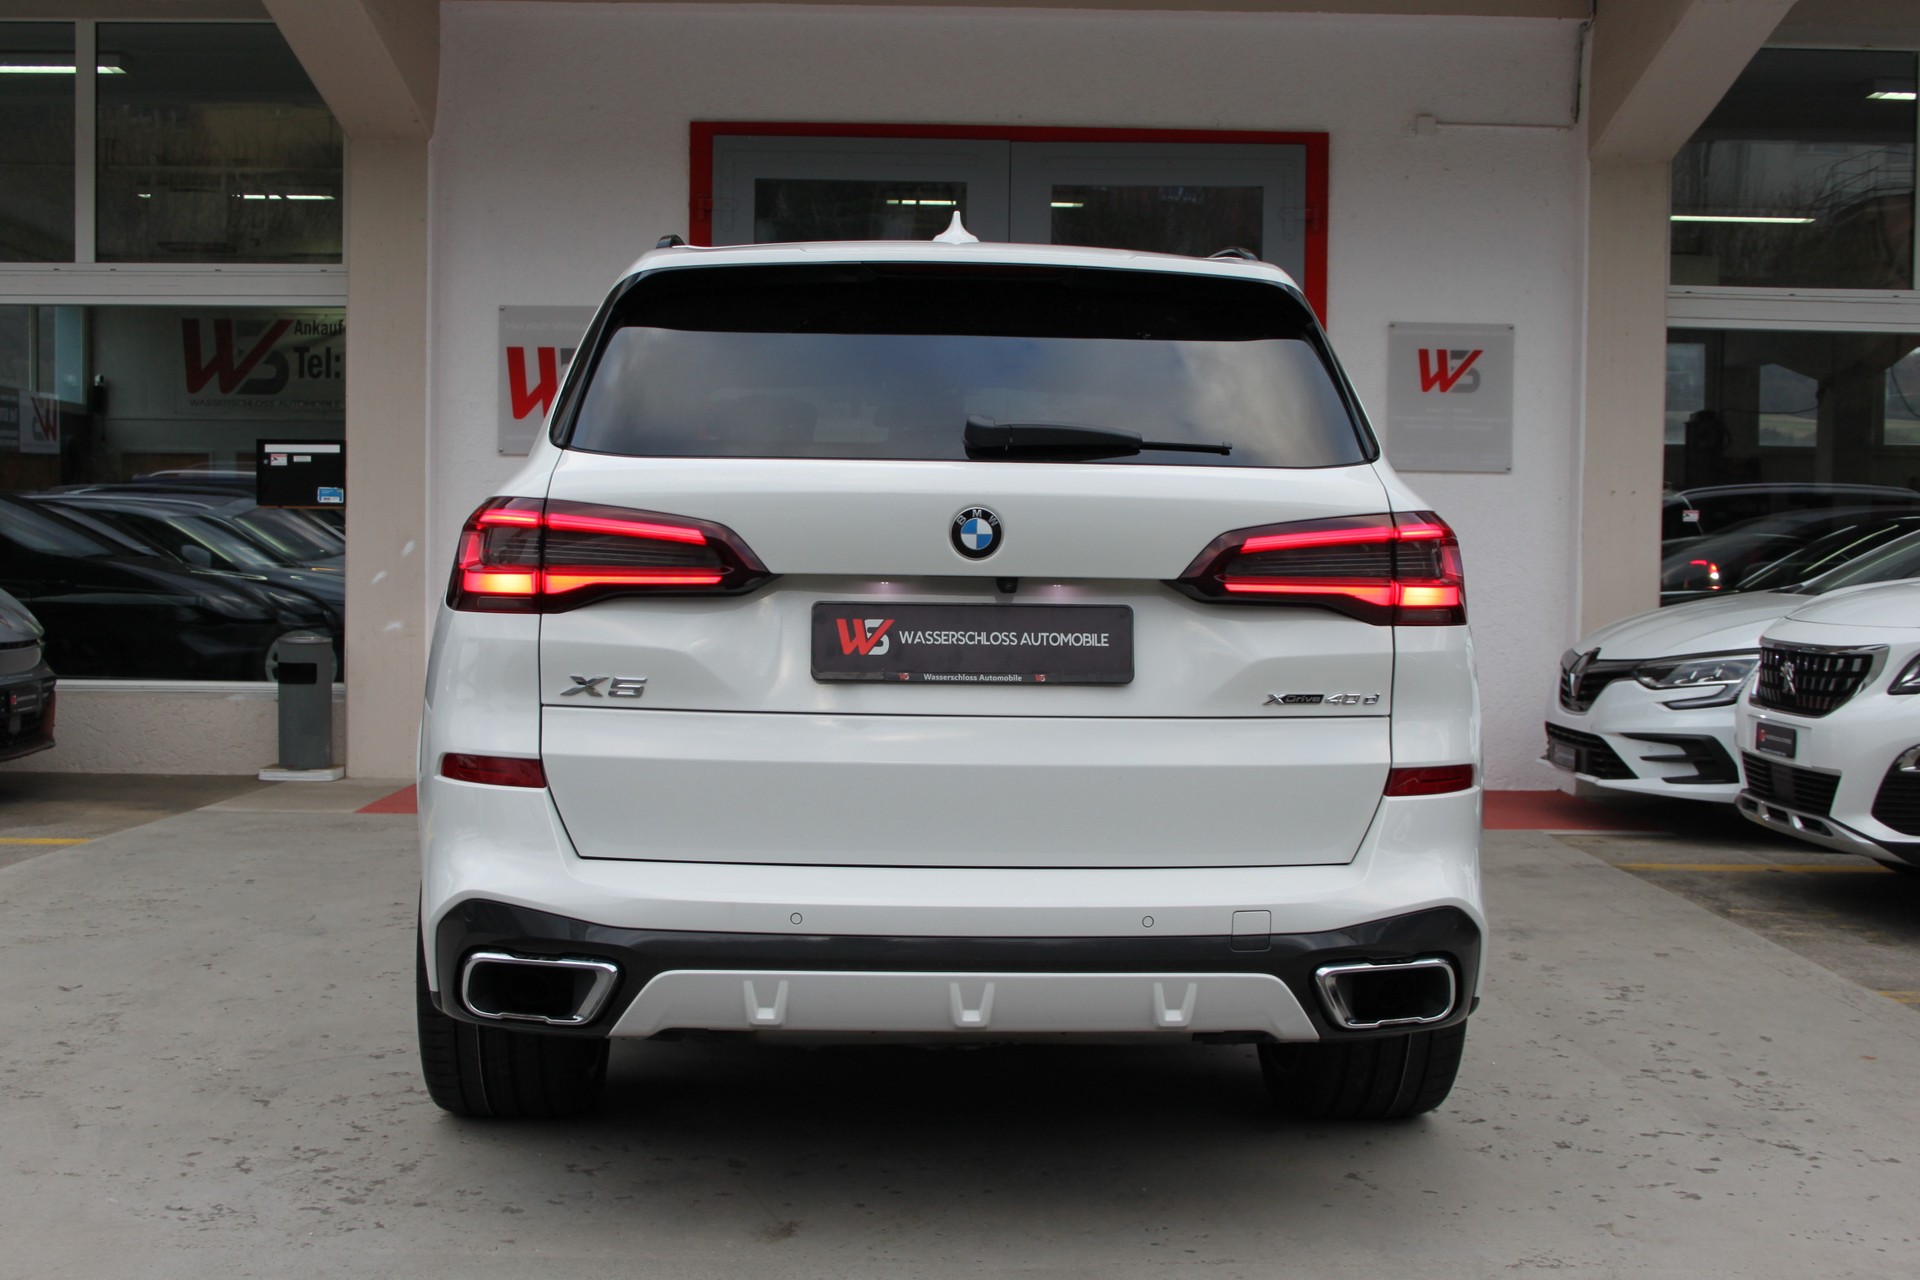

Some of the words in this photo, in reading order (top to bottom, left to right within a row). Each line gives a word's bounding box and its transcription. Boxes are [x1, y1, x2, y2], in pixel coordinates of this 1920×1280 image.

[294, 347, 341, 379] Tel:
[956, 509, 999, 527] BMW
[898, 630, 1019, 646] WASSERSCHLOSS
[1020, 632, 1110, 647] AUTOMOBILE
[560, 675, 648, 699] X5
[923, 673, 978, 682] Wasserschloss
[979, 674, 1023, 683] Automobile
